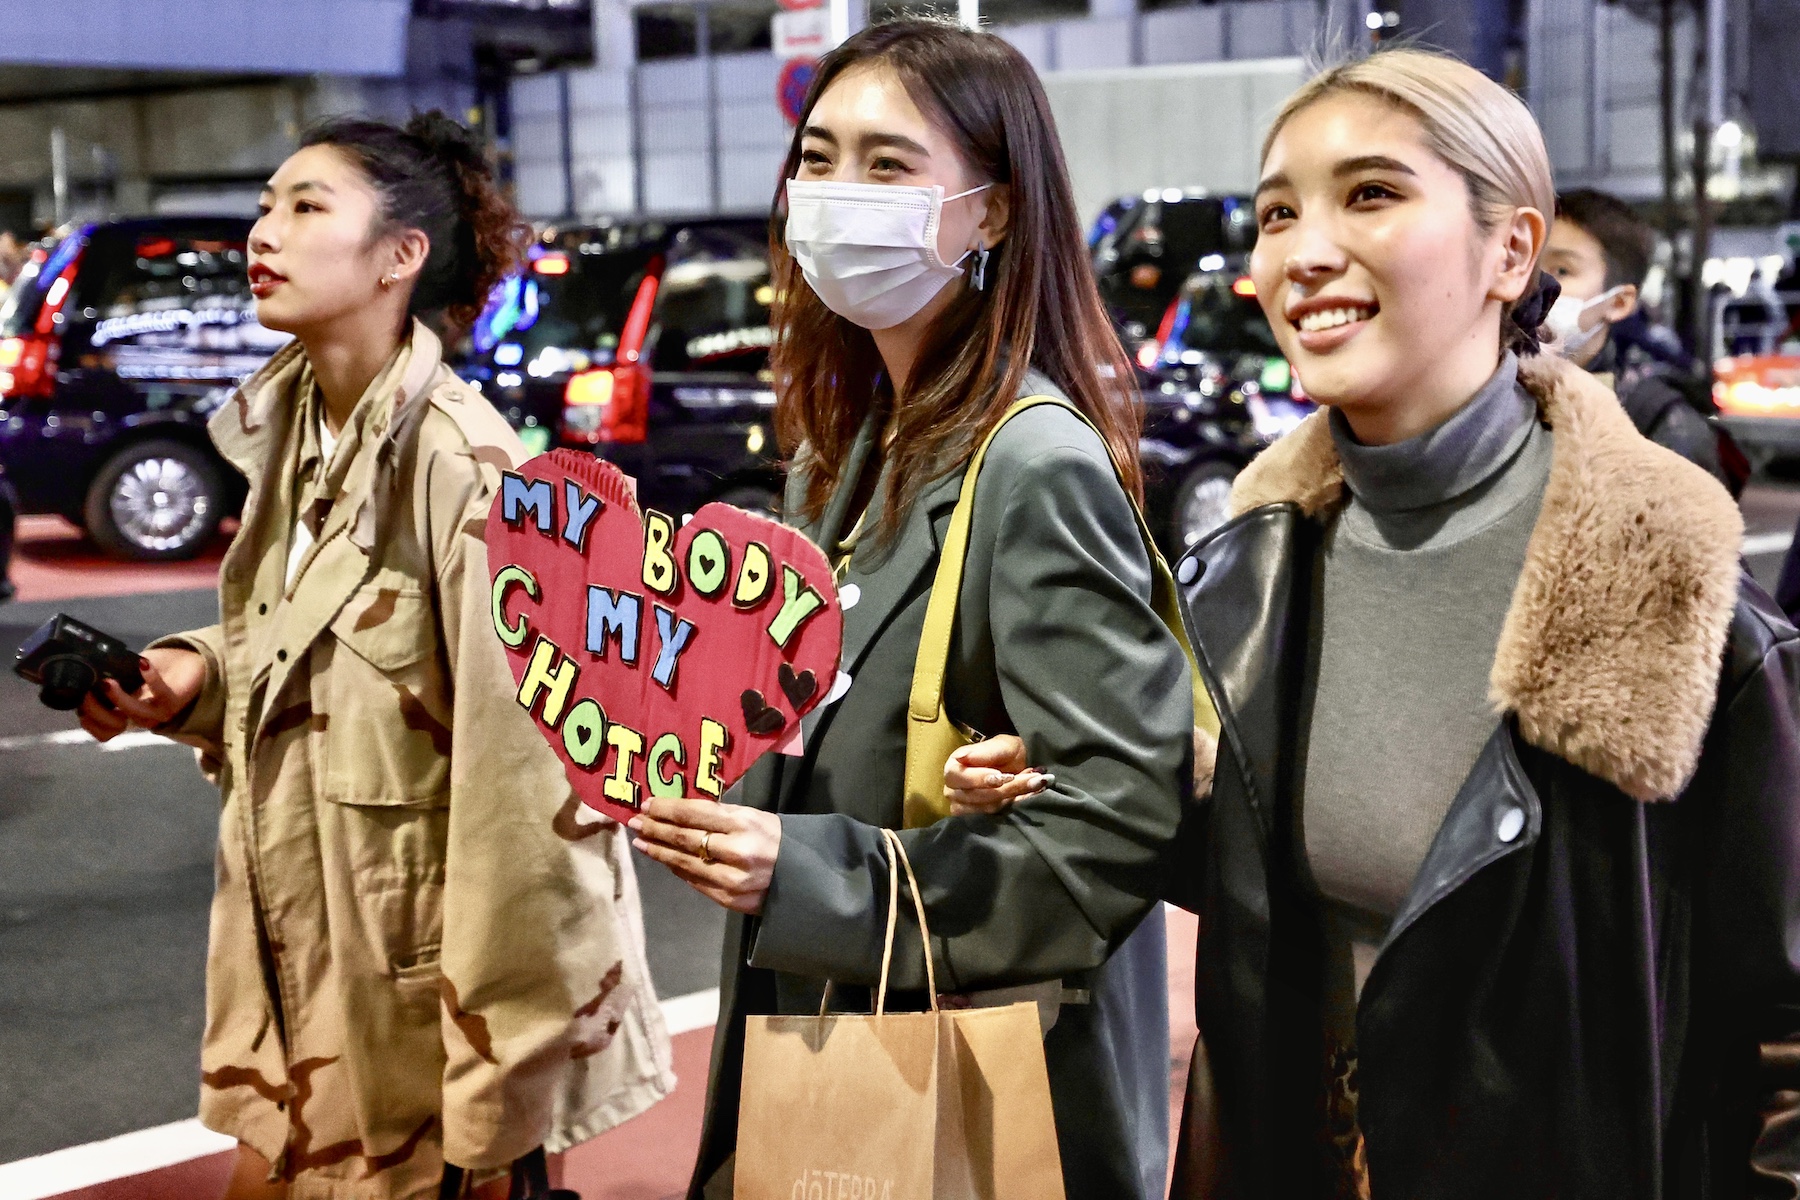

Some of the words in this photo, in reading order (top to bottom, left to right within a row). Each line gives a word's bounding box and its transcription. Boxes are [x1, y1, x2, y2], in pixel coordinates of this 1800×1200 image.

[501, 469, 603, 552] MY
[641, 508, 827, 650] BODY
[585, 583, 695, 688] MY
[491, 564, 729, 808] CHOICE
